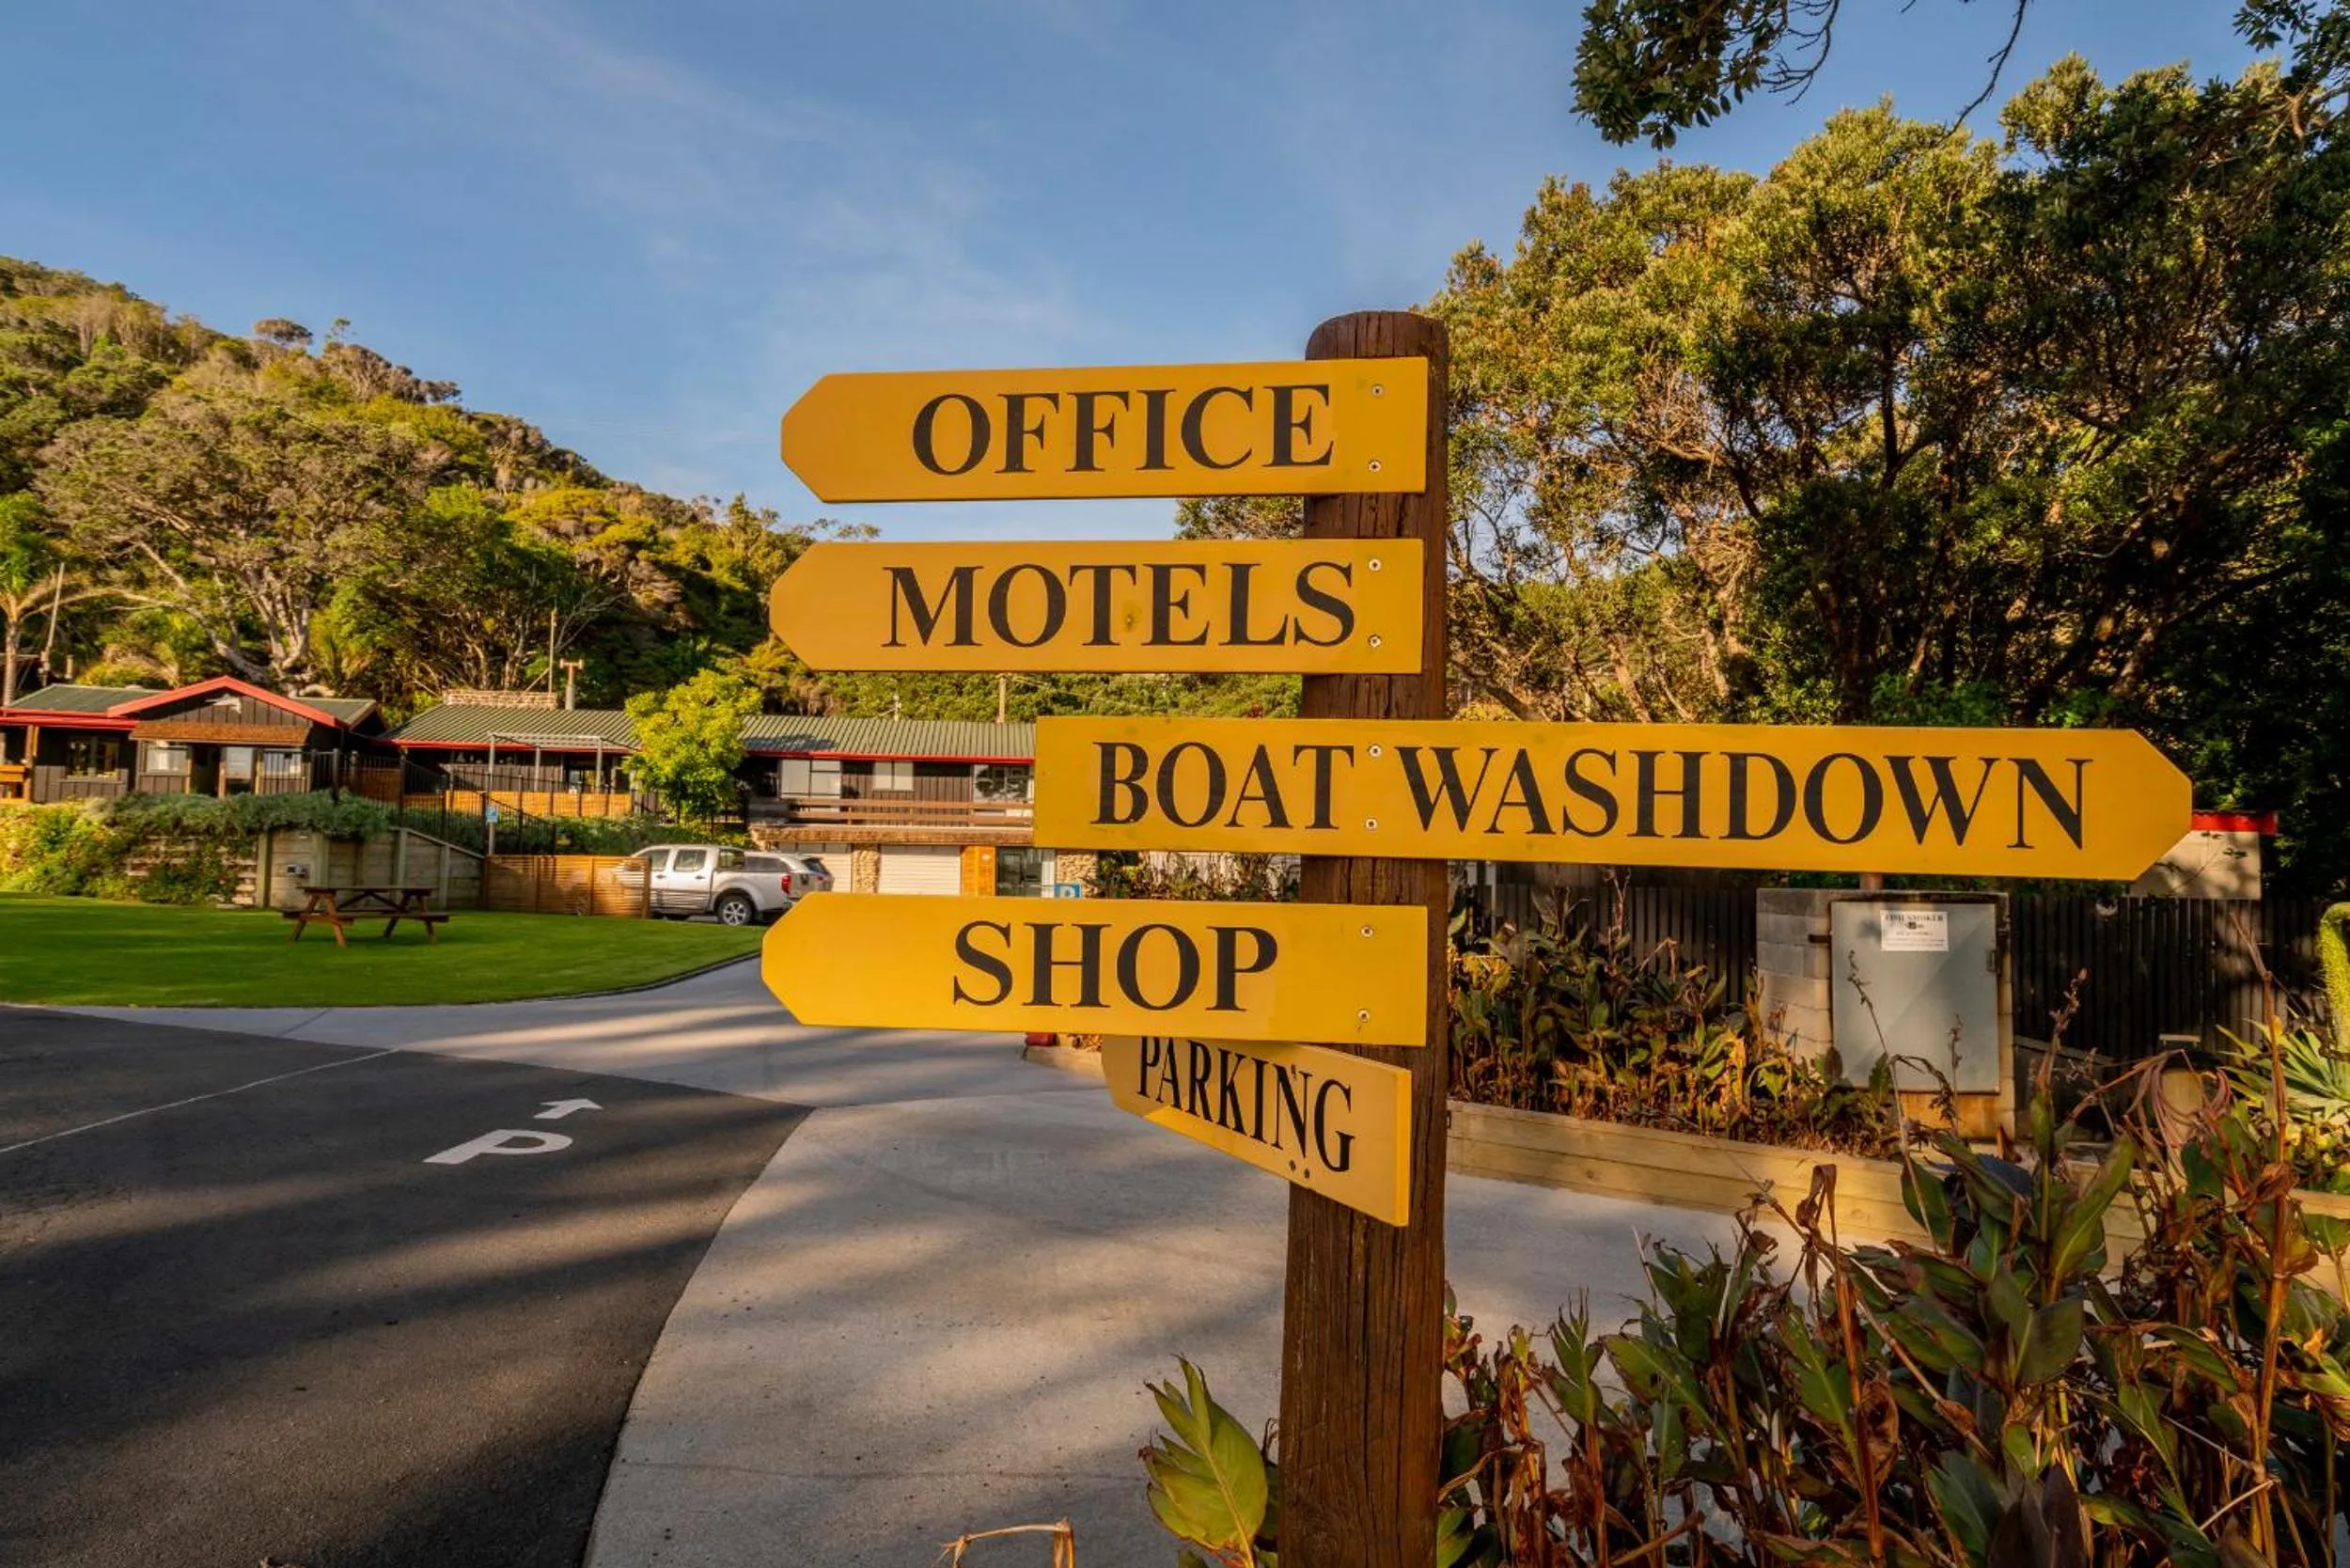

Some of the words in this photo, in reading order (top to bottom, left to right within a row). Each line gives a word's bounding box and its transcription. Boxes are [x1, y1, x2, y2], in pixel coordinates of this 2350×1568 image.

[913, 384, 1335, 476] OFFICE
[882, 561, 1355, 648] MOTELS
[1090, 741, 1356, 829] BOAT
[1395, 745, 2093, 851] WASHDOWN
[953, 921, 1277, 1011] SHOP
[422, 1129, 573, 1165] P
[1136, 1036, 1355, 1173] PARKING
